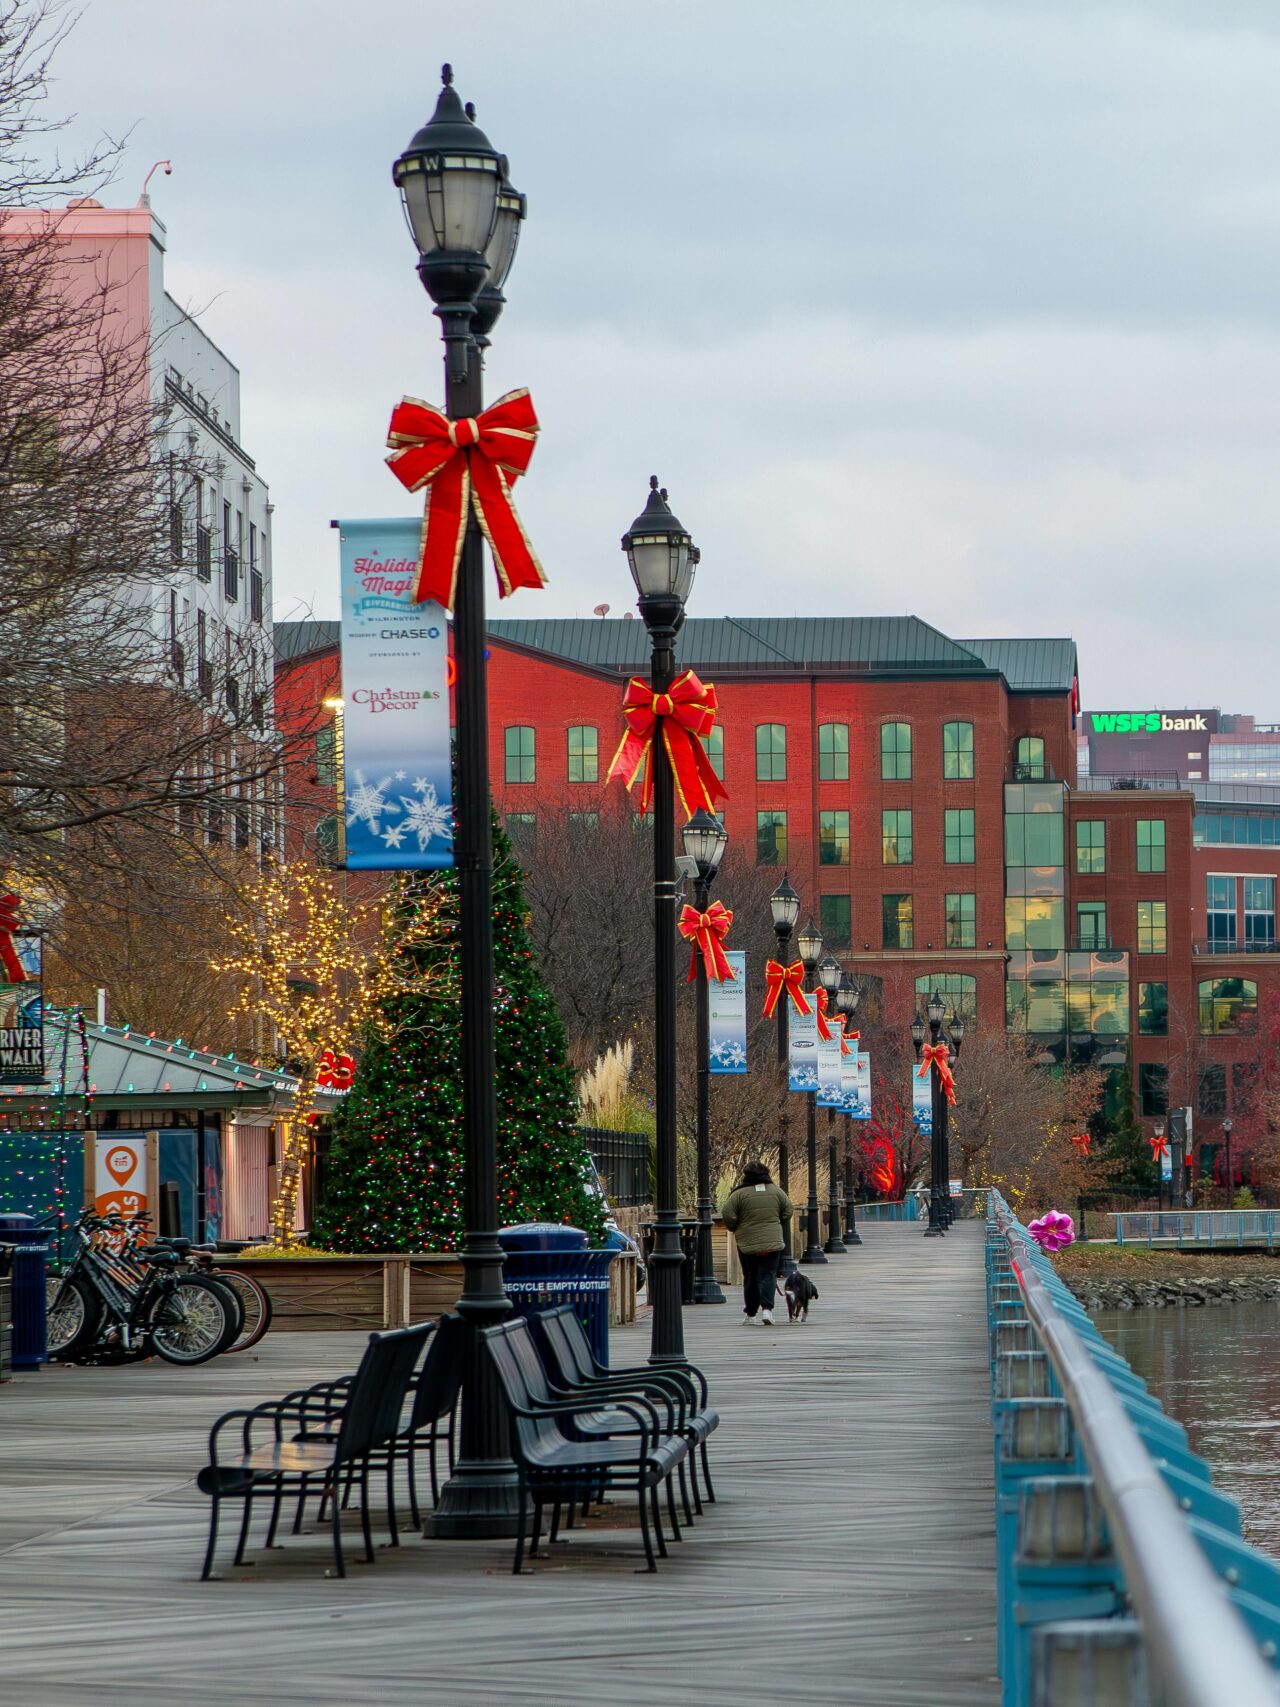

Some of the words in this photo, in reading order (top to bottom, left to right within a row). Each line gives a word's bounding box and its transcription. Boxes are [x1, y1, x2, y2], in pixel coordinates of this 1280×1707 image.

[354, 557, 417, 575] Holida
[361, 576, 414, 596] Magi
[380, 628, 428, 639] CHASE
[369, 700, 419, 713] Decor
[0, 1029, 42, 1048] RIVER
[1, 1049, 42, 1066] WALK
[502, 1282, 545, 1292] RECYCLE
[546, 1281, 578, 1291] EMPTY
